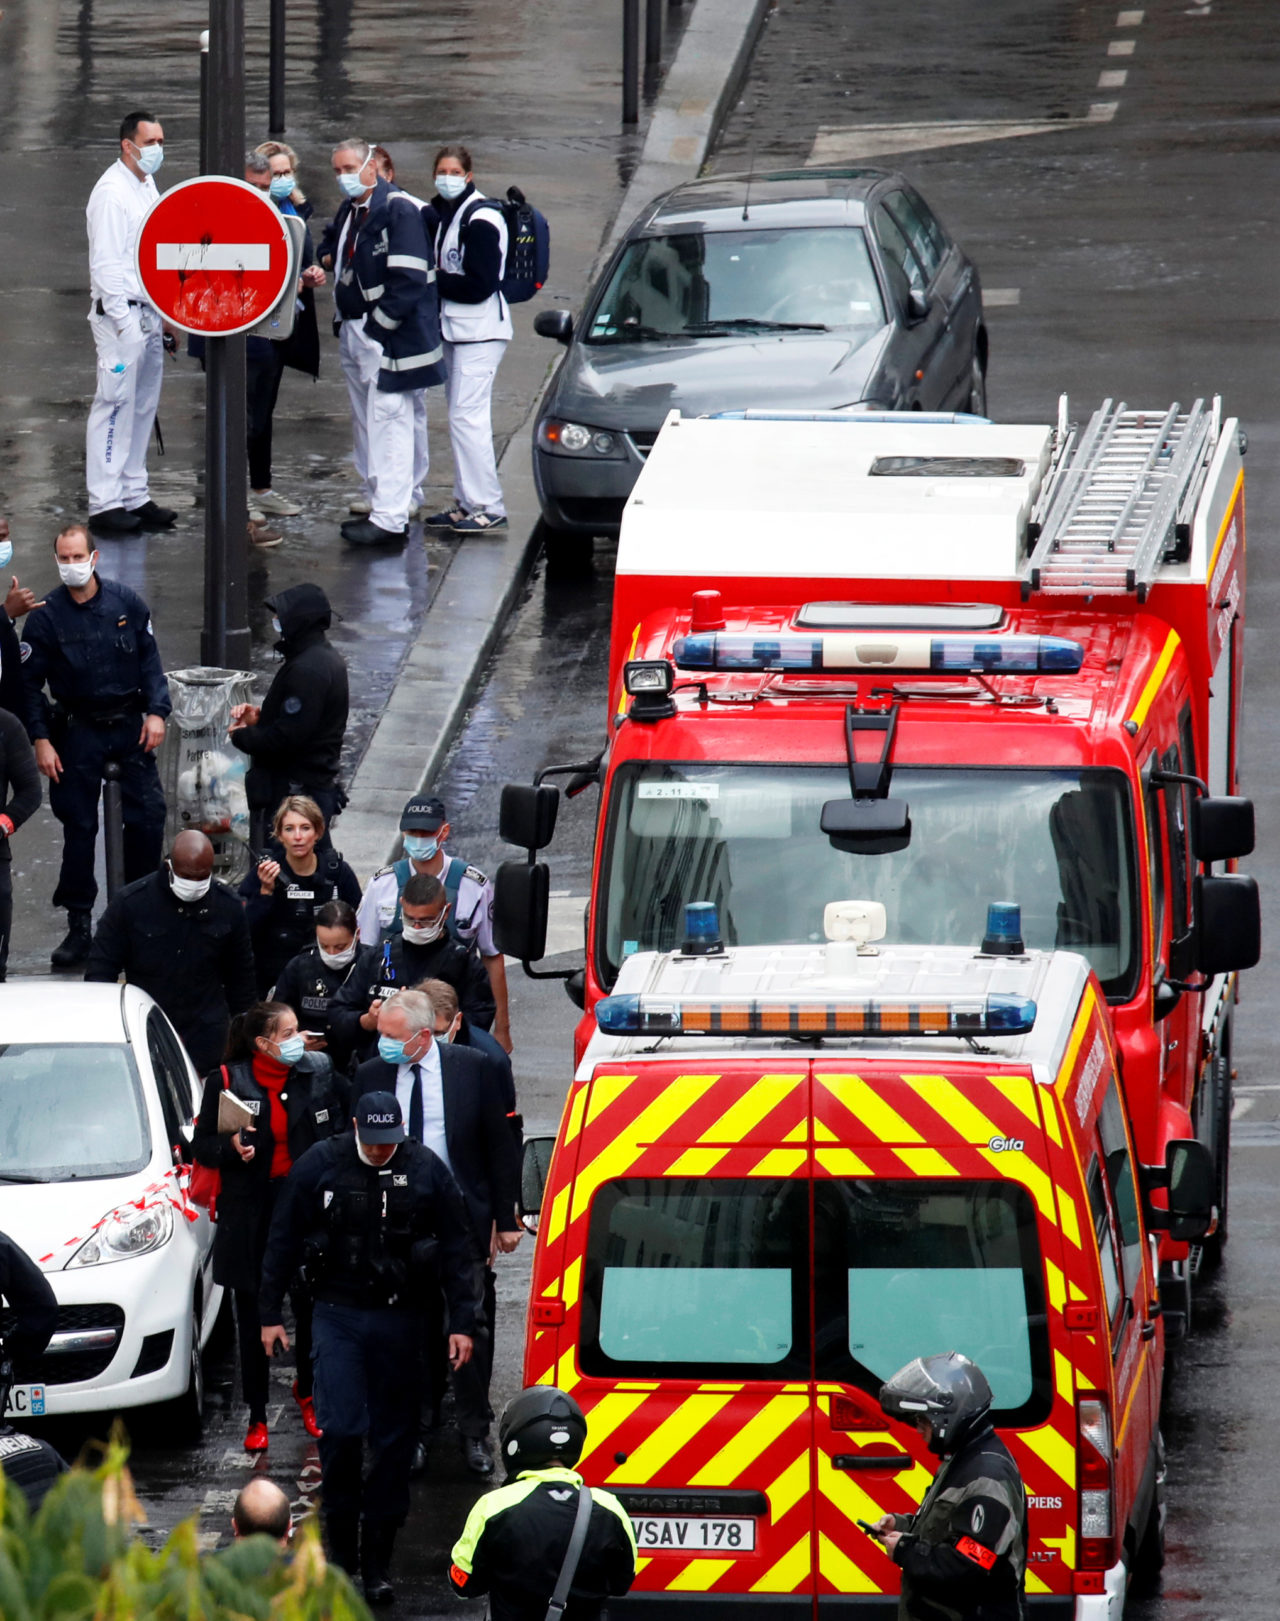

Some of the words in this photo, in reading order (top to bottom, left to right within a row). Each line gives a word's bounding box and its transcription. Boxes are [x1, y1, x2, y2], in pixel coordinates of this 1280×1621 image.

[105, 427, 115, 464] NECKER
[407, 805, 433, 814] POLICE
[303, 997, 328, 1010] POLIC
[367, 1113, 395, 1124] POLICE
[988, 1136, 1025, 1153] Gifa
[32, 1401, 45, 1413] 95
[628, 1497, 721, 1510] MASTER
[1027, 1496, 1063, 1509] PIERS
[631, 1521, 689, 1545] VSAV
[700, 1522, 742, 1547] 178
[963, 1537, 994, 1563] POLICE
